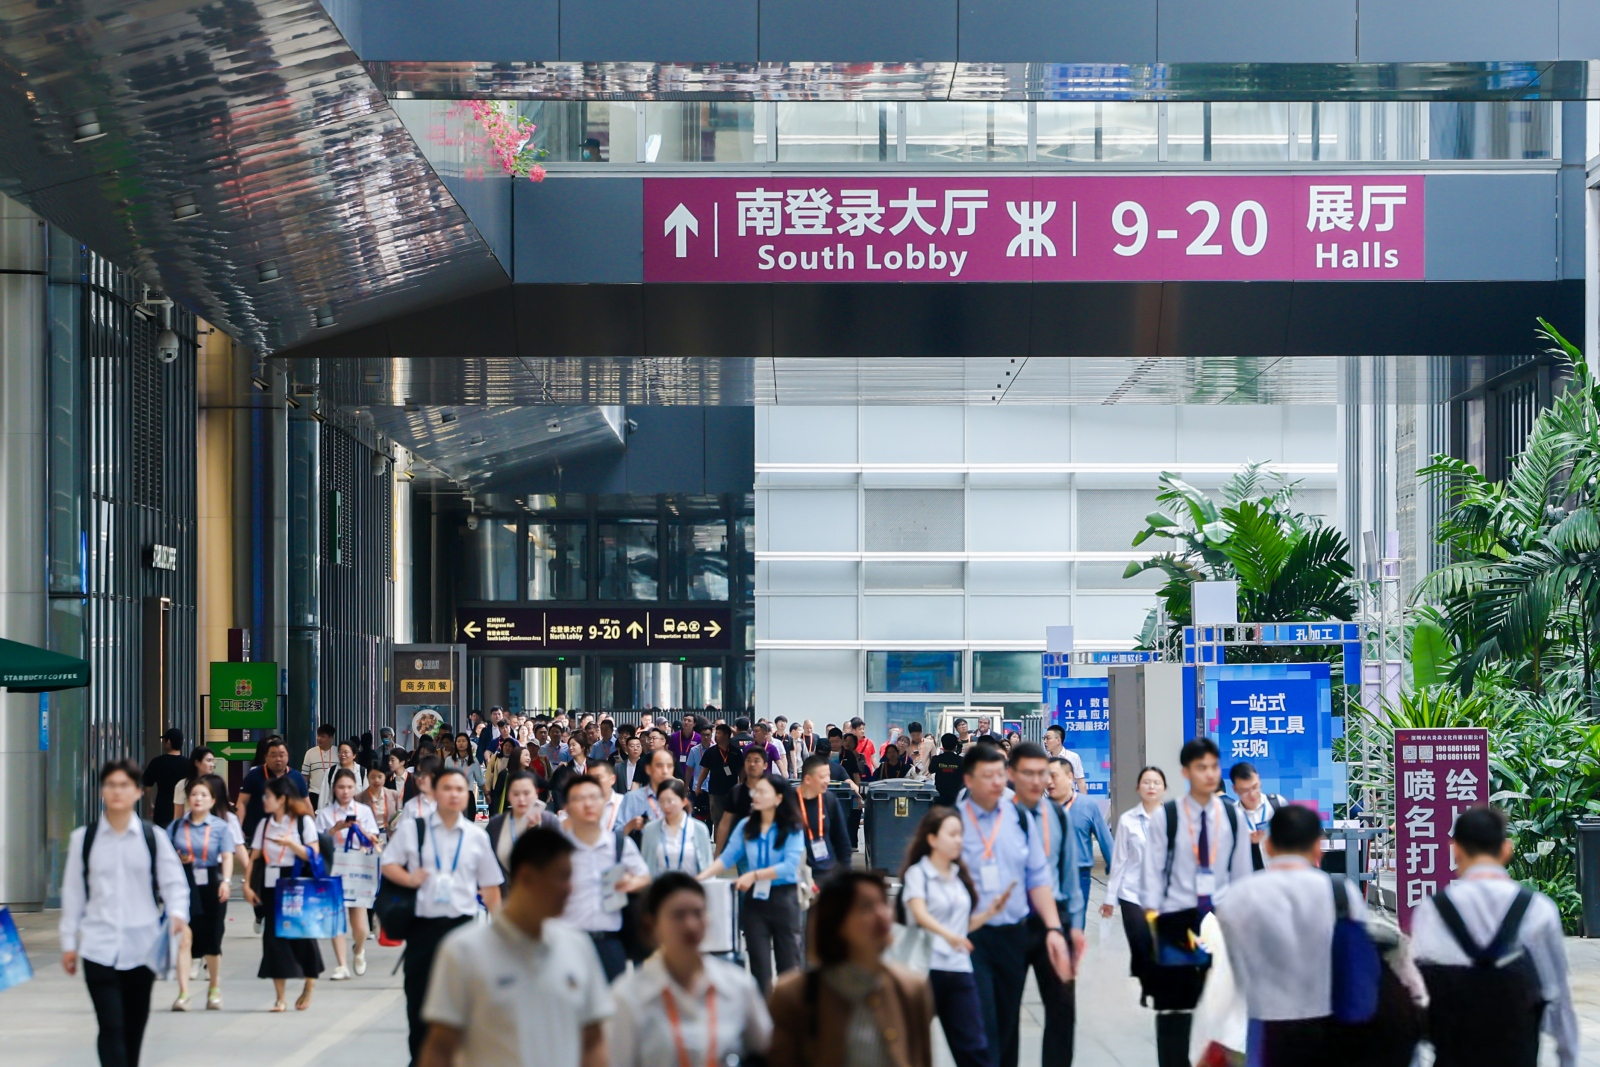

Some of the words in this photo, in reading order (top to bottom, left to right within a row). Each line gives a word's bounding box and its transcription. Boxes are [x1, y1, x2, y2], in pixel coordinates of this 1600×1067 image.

[736, 188, 989, 237] 南登录大厅
[1306, 185, 1407, 232] 展厅
[1111, 200, 1268, 256] 9-20
[758, 244, 854, 269] South
[867, 244, 967, 277] Lobby
[1316, 242, 1399, 269] Halls
[566, 633, 584, 642] Lobby
[588, 625, 621, 640] 9-20
[1295, 628, 1334, 641] 孔加工
[3, 674, 47, 682] STARBUCKS
[405, 681, 448, 691] 商务简餐
[1230, 692, 1287, 713] 一站式
[1231, 715, 1306, 735] 刀具工具
[1231, 739, 1269, 758] 采购
